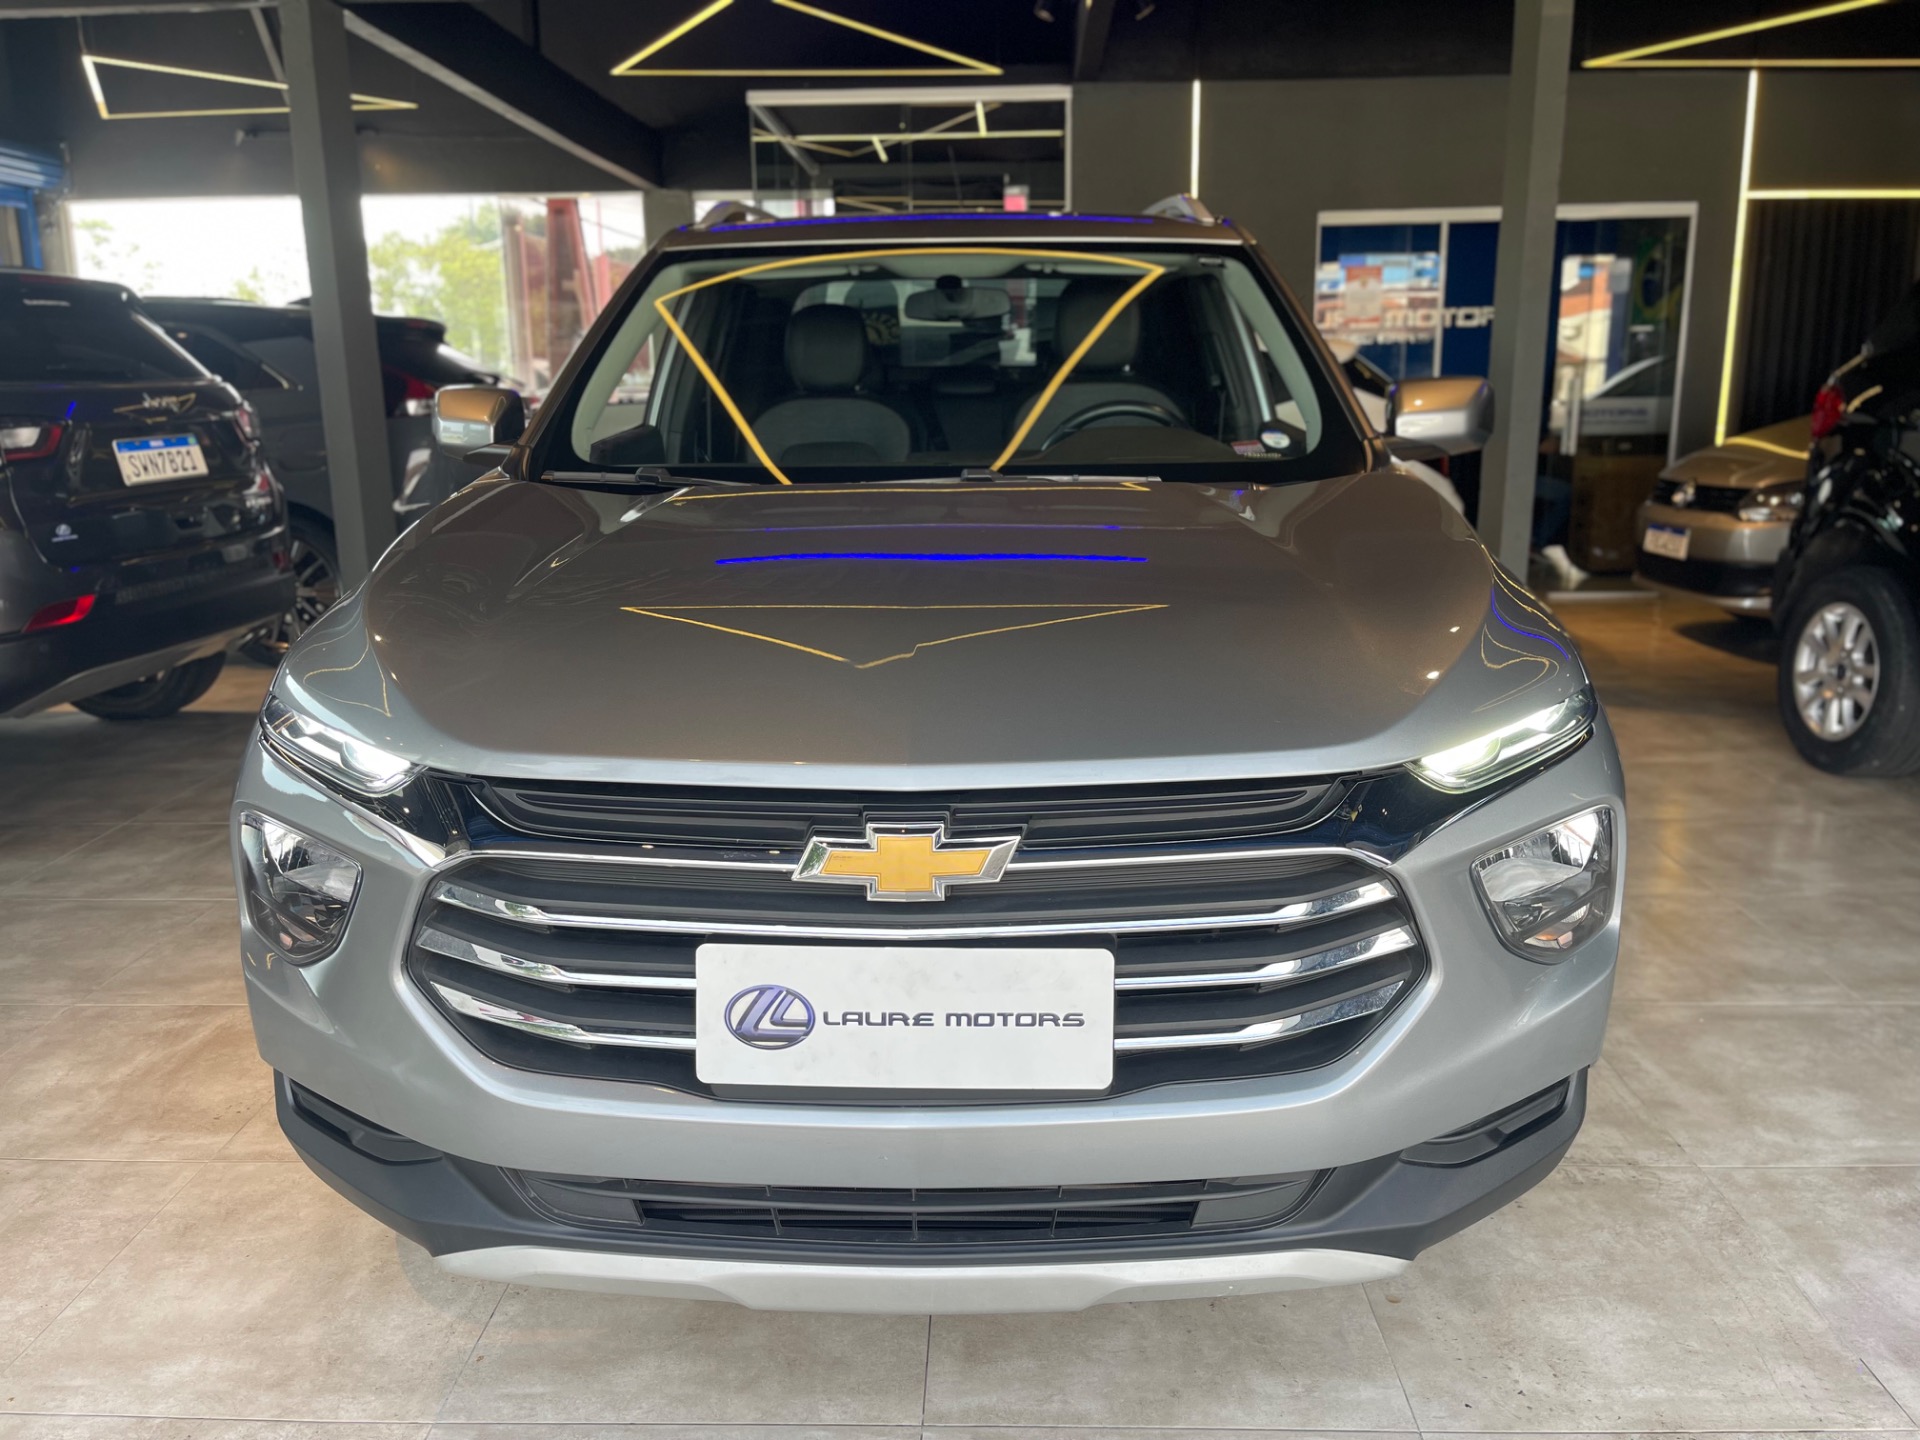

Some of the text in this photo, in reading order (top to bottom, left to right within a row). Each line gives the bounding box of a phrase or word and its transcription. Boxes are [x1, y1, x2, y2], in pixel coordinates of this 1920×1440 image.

[127, 449, 198, 478] SWN7B21
[823, 1009, 935, 1027] LAURE
[945, 1011, 1086, 1029] MOTORS
